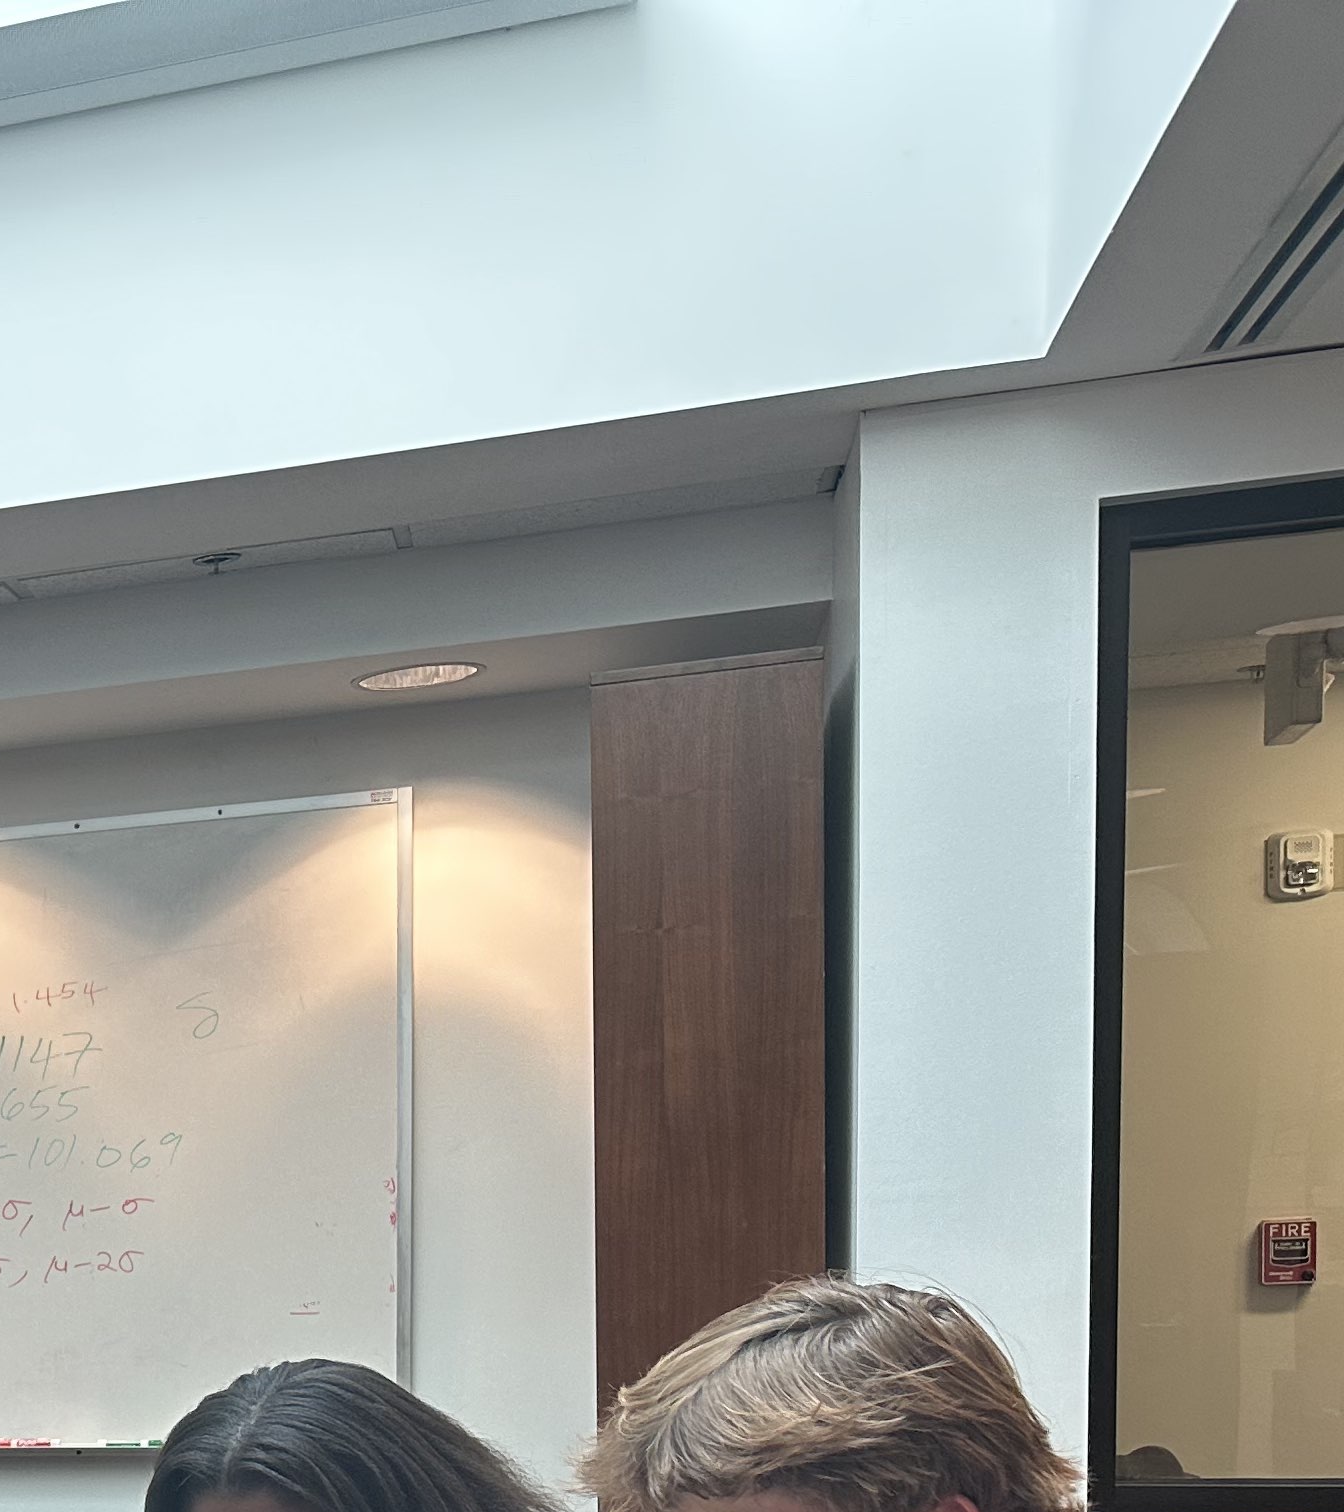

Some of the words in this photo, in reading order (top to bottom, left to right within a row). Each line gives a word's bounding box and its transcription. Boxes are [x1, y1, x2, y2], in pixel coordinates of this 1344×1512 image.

[12, 979, 109, 1014] 1.454
[0, 1086, 91, 1123] 655
[27, 1131, 184, 1173] 101.069
[1269, 1222, 1312, 1237] FIRE
